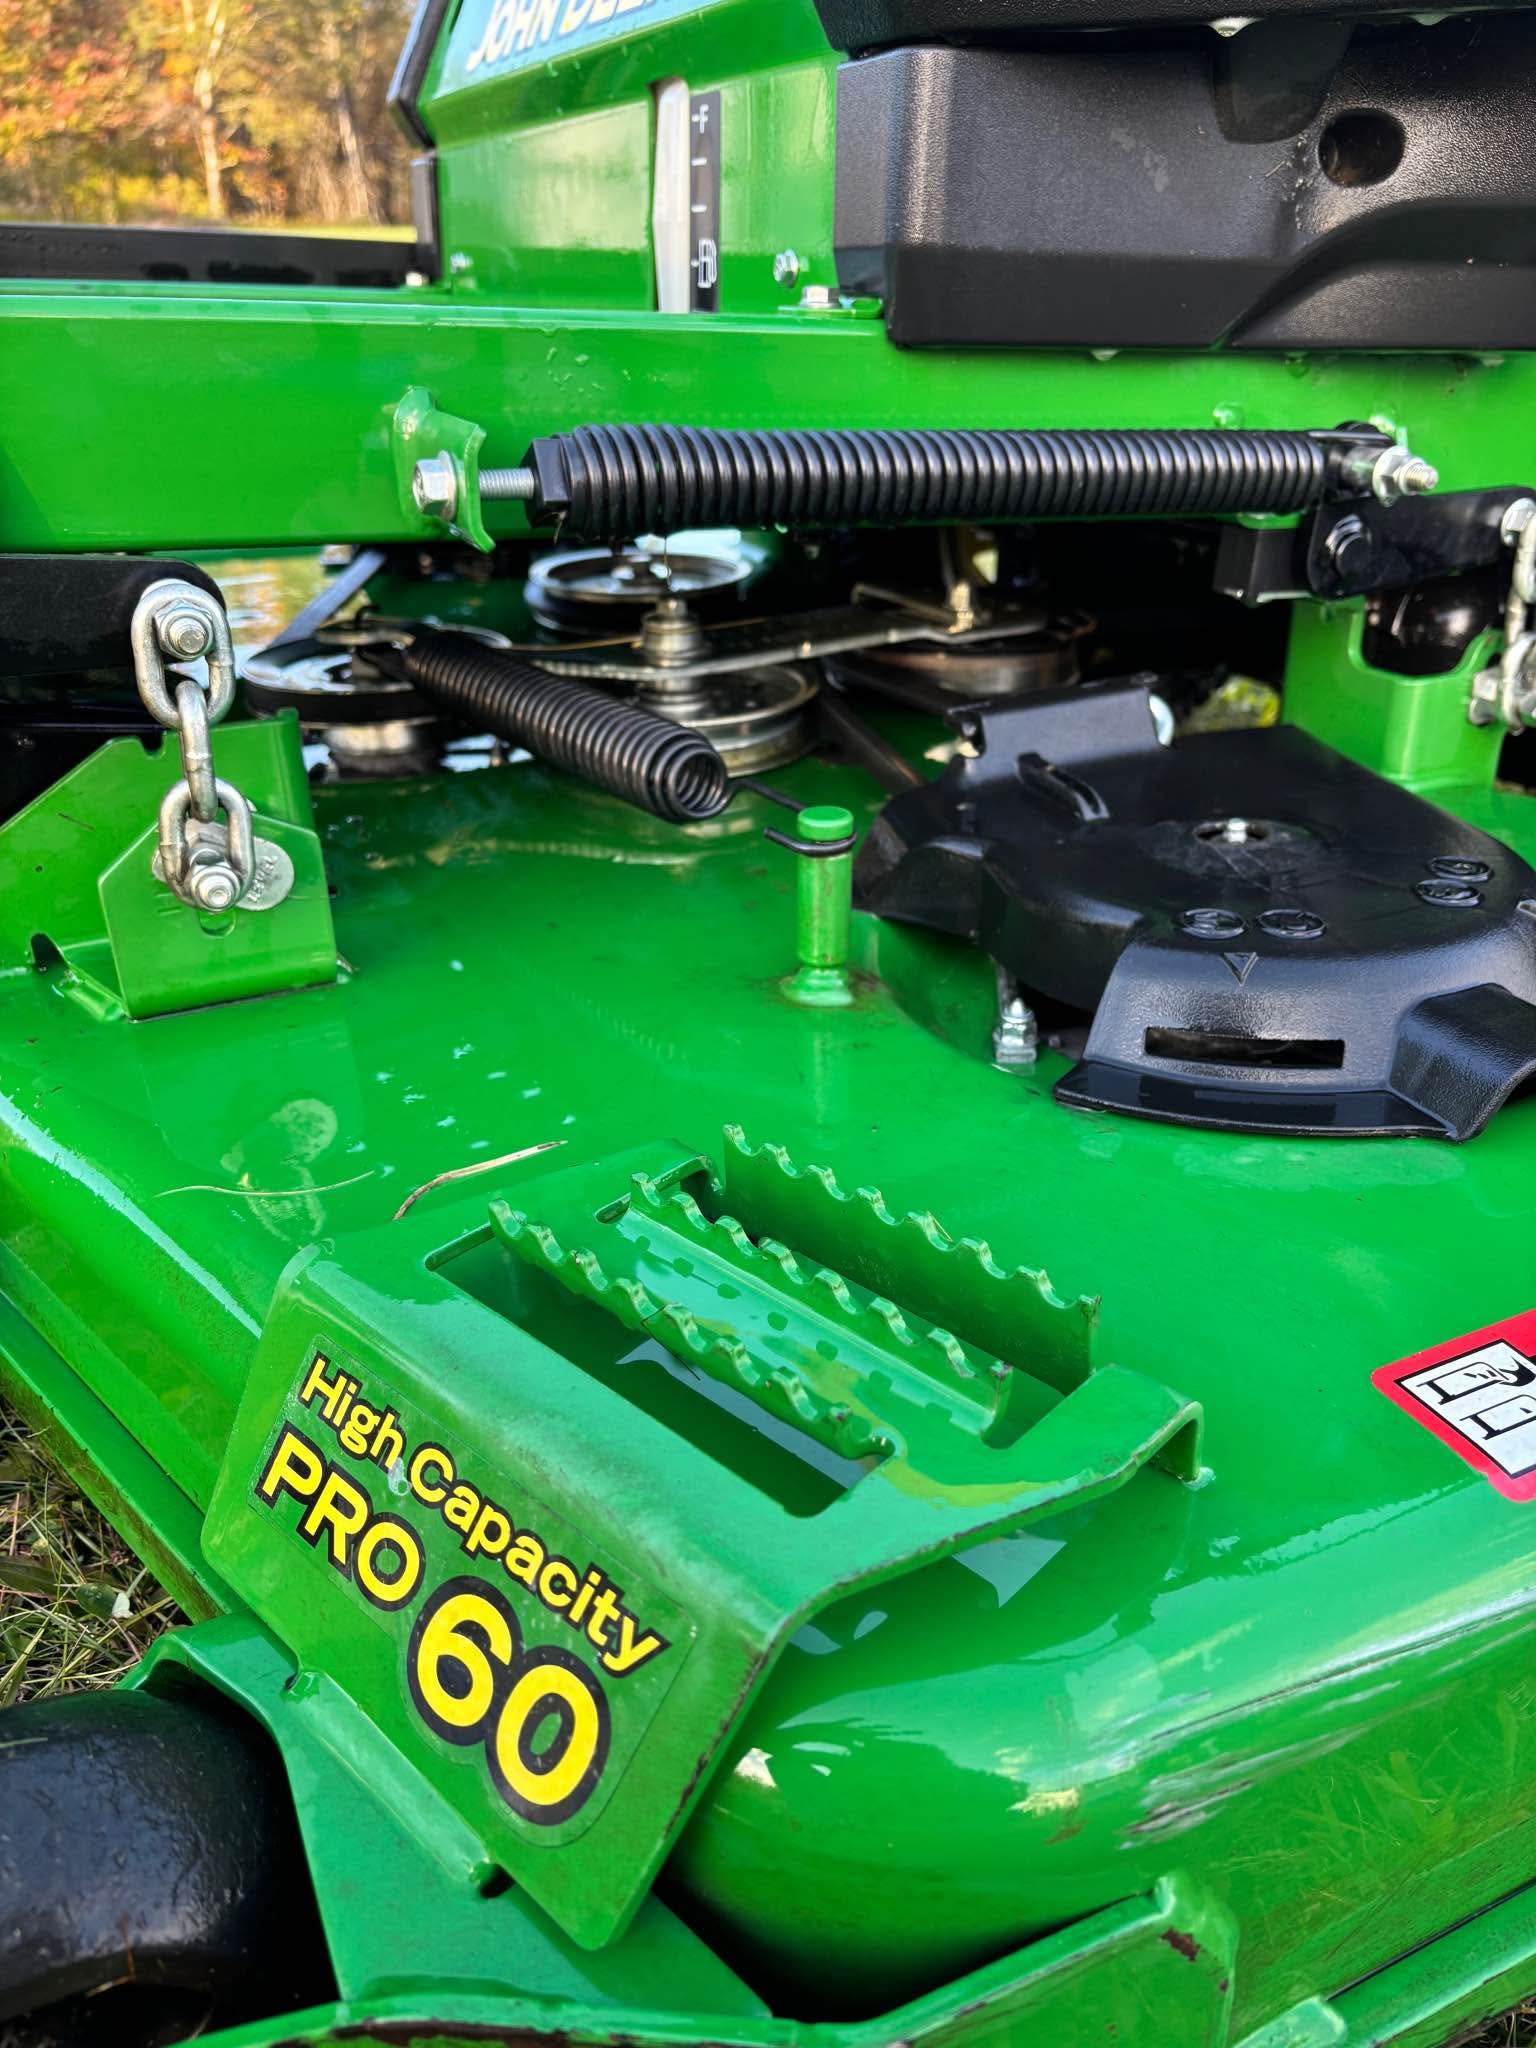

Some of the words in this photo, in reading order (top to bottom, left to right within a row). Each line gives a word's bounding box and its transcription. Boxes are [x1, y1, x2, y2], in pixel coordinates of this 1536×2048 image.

[464, 0, 560, 71] JOHN
[260, 1428, 423, 1606] PRO
[412, 1585, 605, 1814] 60
[300, 1355, 405, 1473] High
[407, 1445, 664, 1675] Capacity
